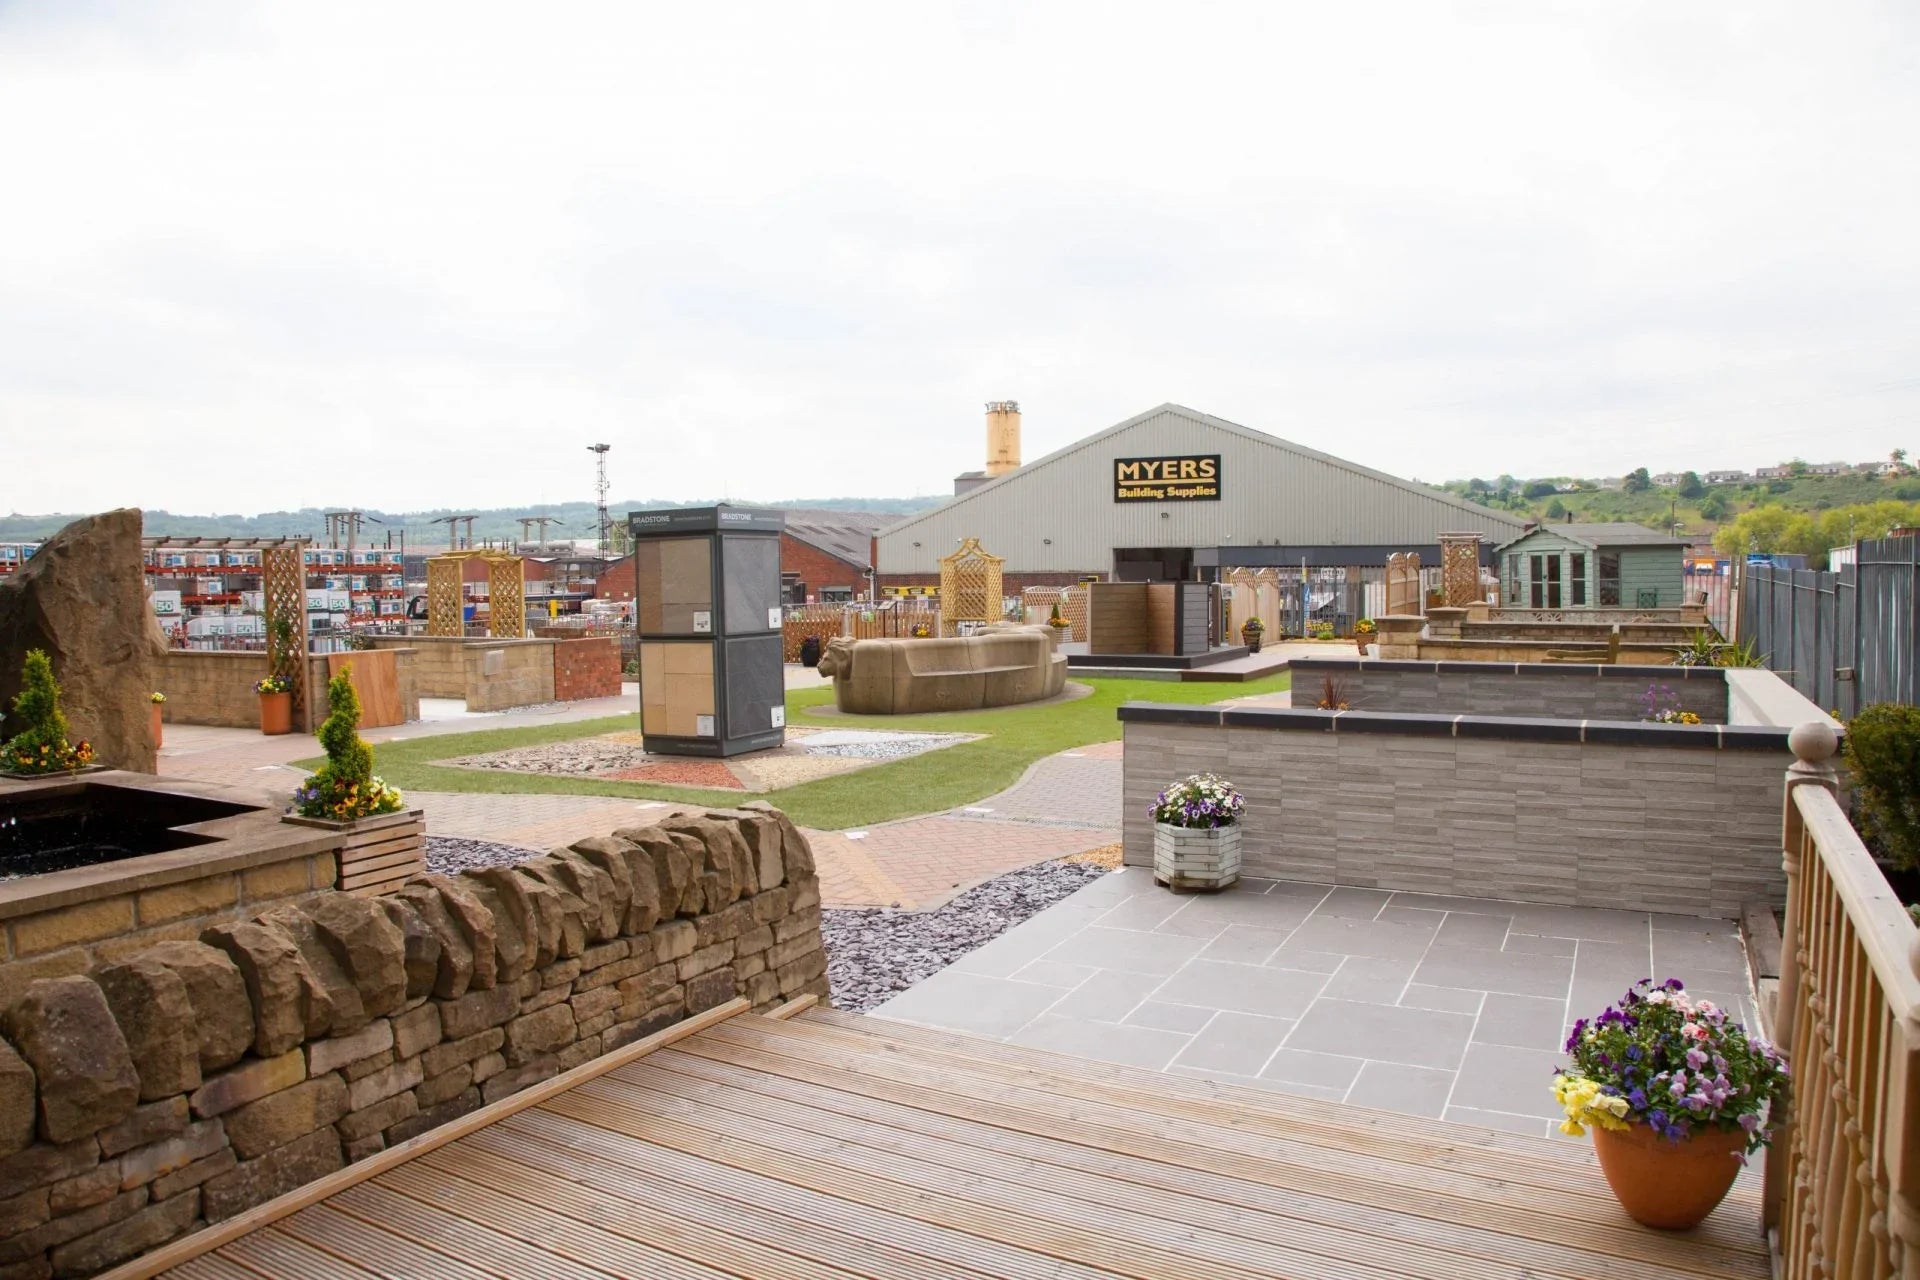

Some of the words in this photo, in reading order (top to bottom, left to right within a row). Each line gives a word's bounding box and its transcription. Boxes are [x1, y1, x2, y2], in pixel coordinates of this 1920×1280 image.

[1118, 459, 1216, 480] MYERS
[1118, 487, 1164, 499] Building
[1167, 486, 1216, 498] Supplies
[632, 515, 671, 525] BRADSTONE
[721, 512, 752, 521] BRADSTONE
[156, 600, 174, 612] 50
[308, 599, 322, 607] 50
[331, 599, 345, 608] 50
